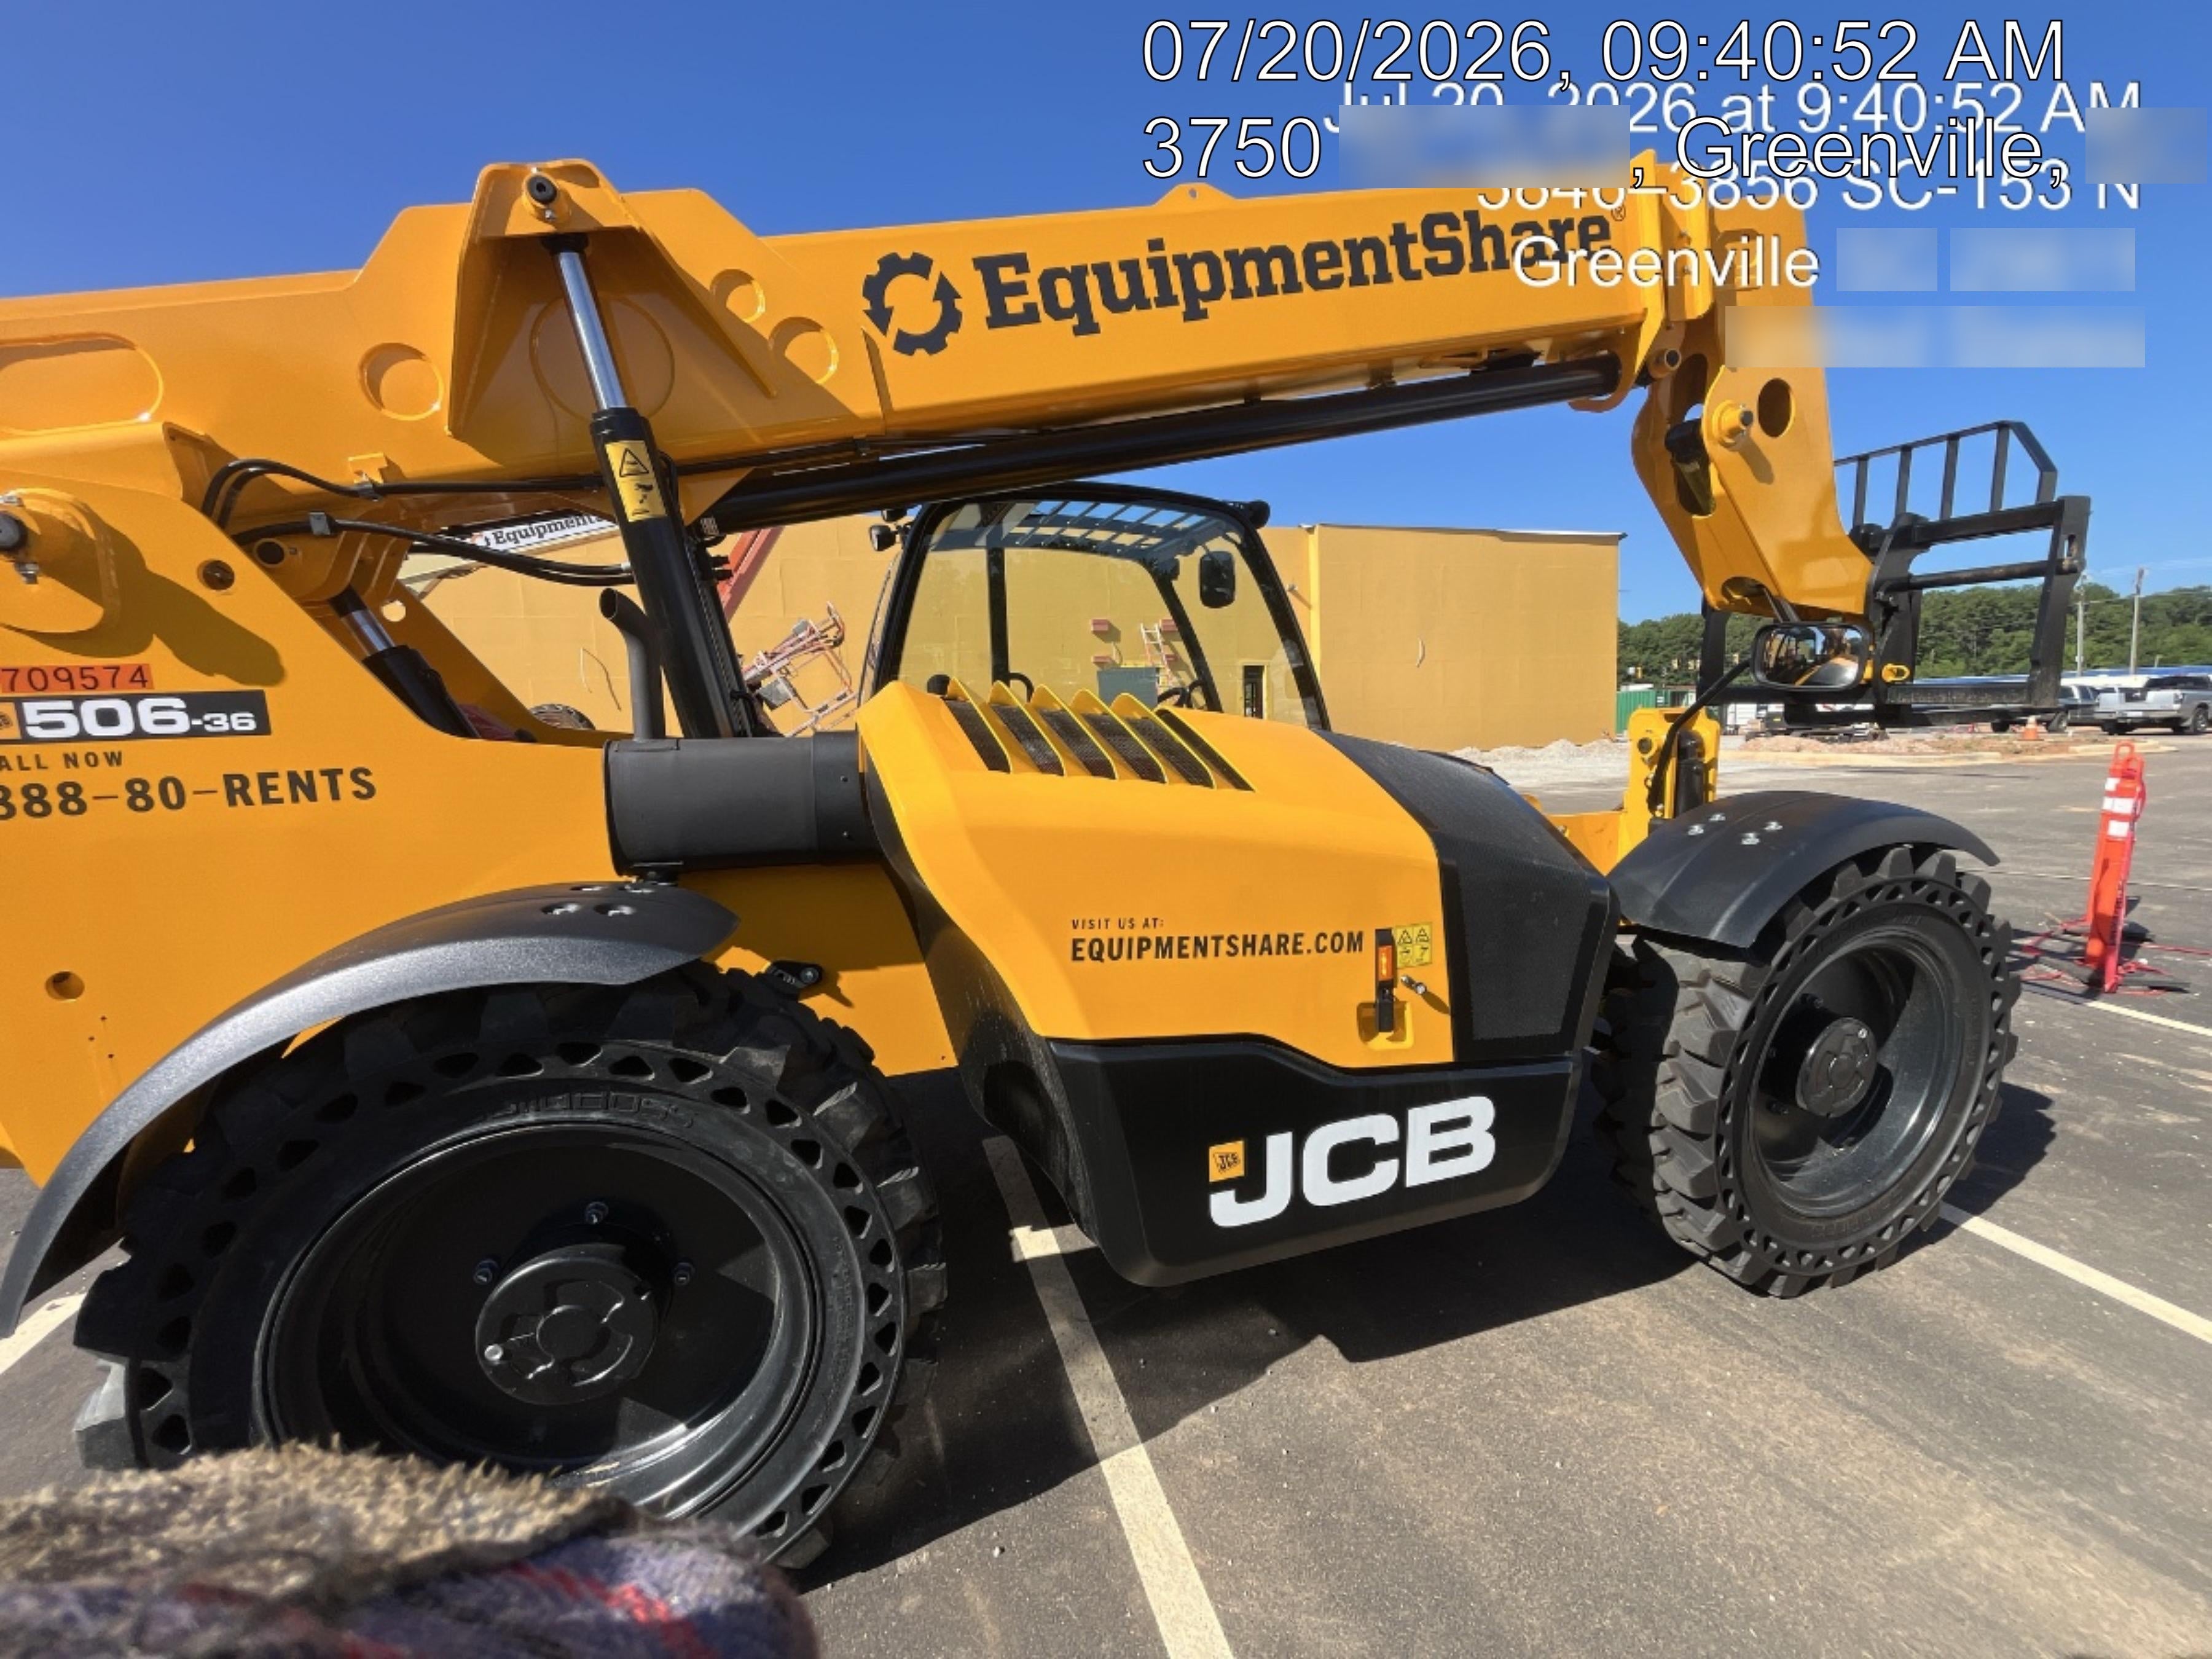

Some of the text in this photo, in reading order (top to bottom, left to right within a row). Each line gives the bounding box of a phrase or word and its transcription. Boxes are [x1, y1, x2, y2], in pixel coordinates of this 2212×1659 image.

[1, 665, 148, 692] 709574
[22, 697, 257, 739] 506-36
[63, 750, 123, 769] NOW
[1072, 917, 1164, 930] VISIT US AT:
[1071, 930, 1364, 963] EQUIPMENTSHARE.COM
[1209, 1096, 1496, 1227] JCB
